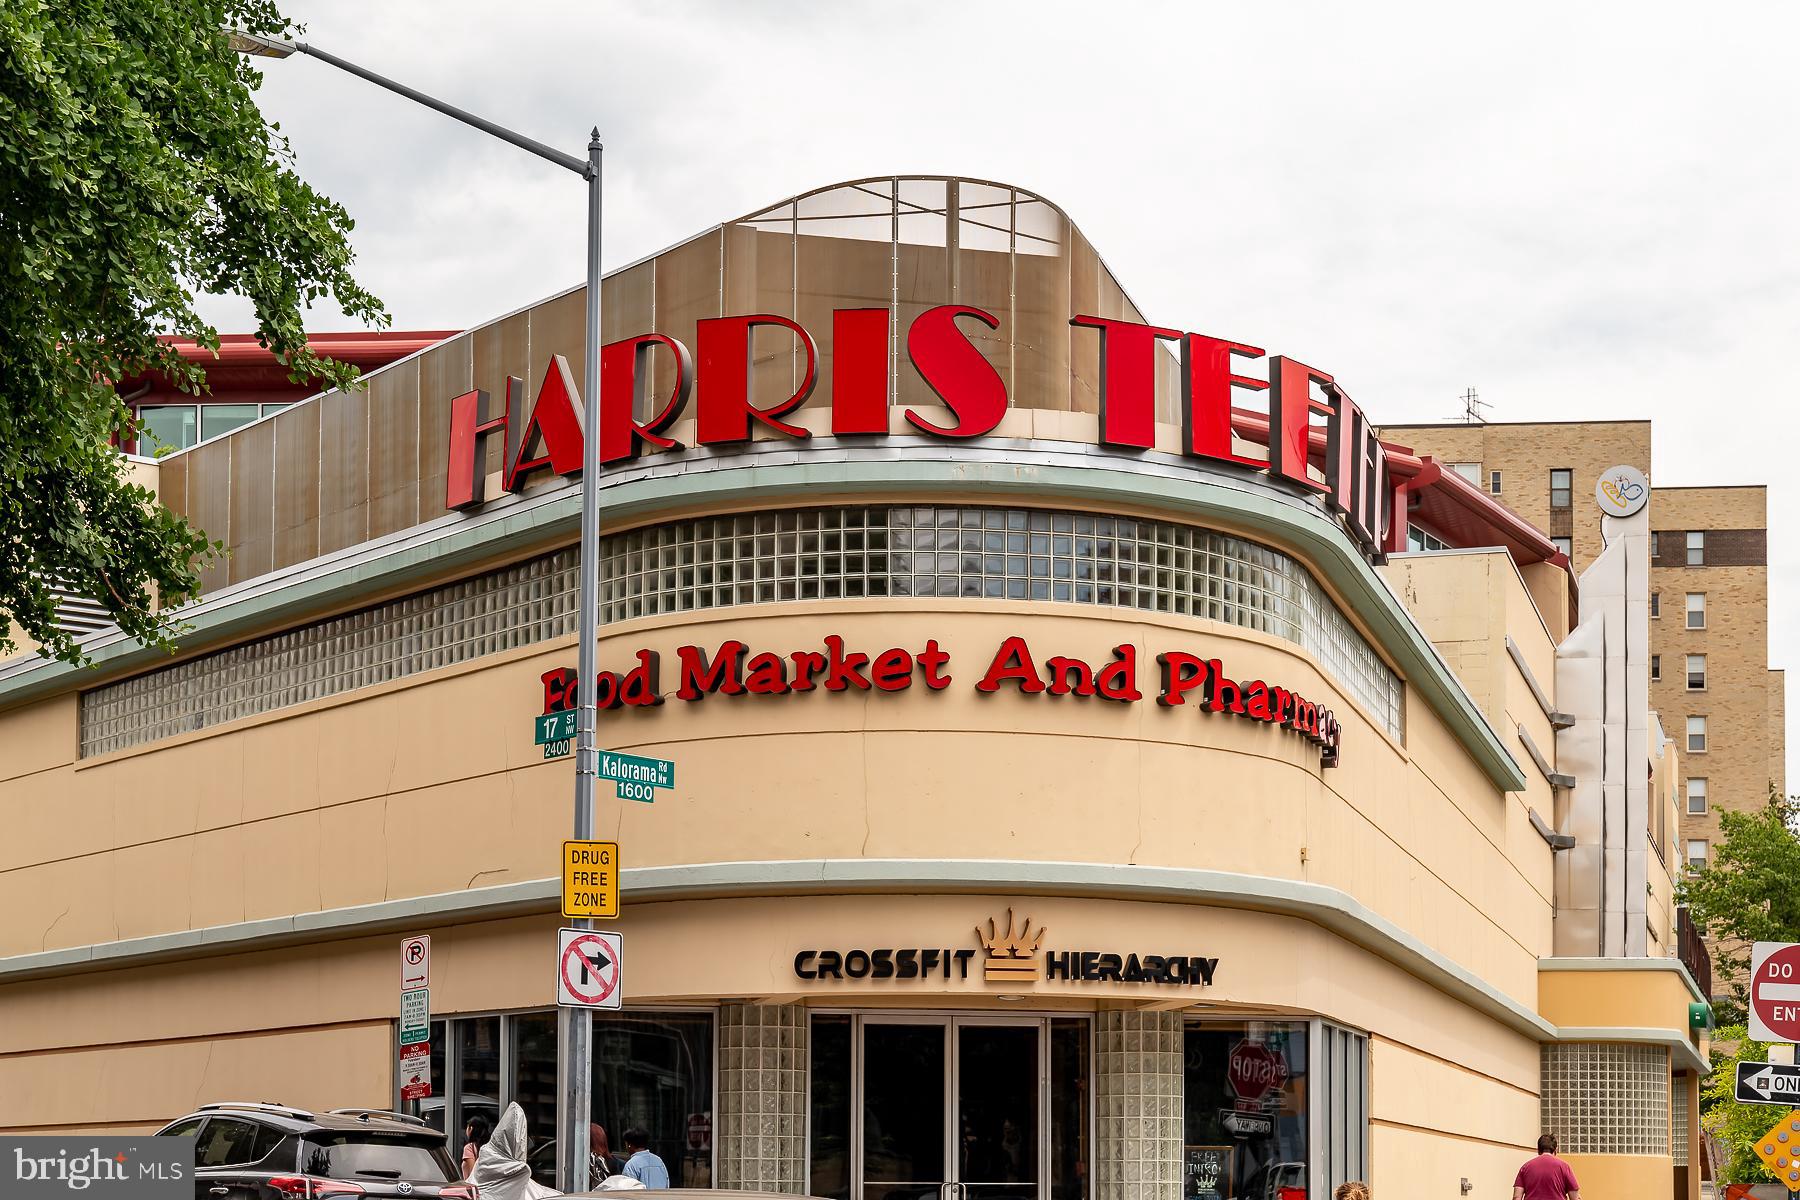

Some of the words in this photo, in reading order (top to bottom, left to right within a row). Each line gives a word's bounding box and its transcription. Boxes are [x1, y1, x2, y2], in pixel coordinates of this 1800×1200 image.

[446, 304, 1009, 511] HARRIS
[676, 634, 952, 701] Market
[976, 636, 1142, 702] And
[1156, 651, 1342, 769] Pharmacy
[543, 717, 558, 739] 17
[566, 713, 575, 724] ST
[565, 724, 575, 735] NW
[544, 739, 570, 757] 2400
[602, 754, 657, 783] Kalorama
[658, 761, 668, 773] Rd
[618, 781, 654, 801] 1600
[571, 850, 610, 865] DRUG
[573, 871, 608, 887] FREE
[574, 892, 607, 907] ZONE
[794, 948, 976, 980] CROSSFIT
[1046, 950, 1220, 987] HIERARCHY
[1768, 962, 1793, 978] DO
[403, 994, 413, 1003] TWO
[406, 999, 424, 1008] PARKING
[1773, 1006, 1800, 1021] EN
[403, 1050, 427, 1059] PARKING
[1774, 1076, 1800, 1093] ON
